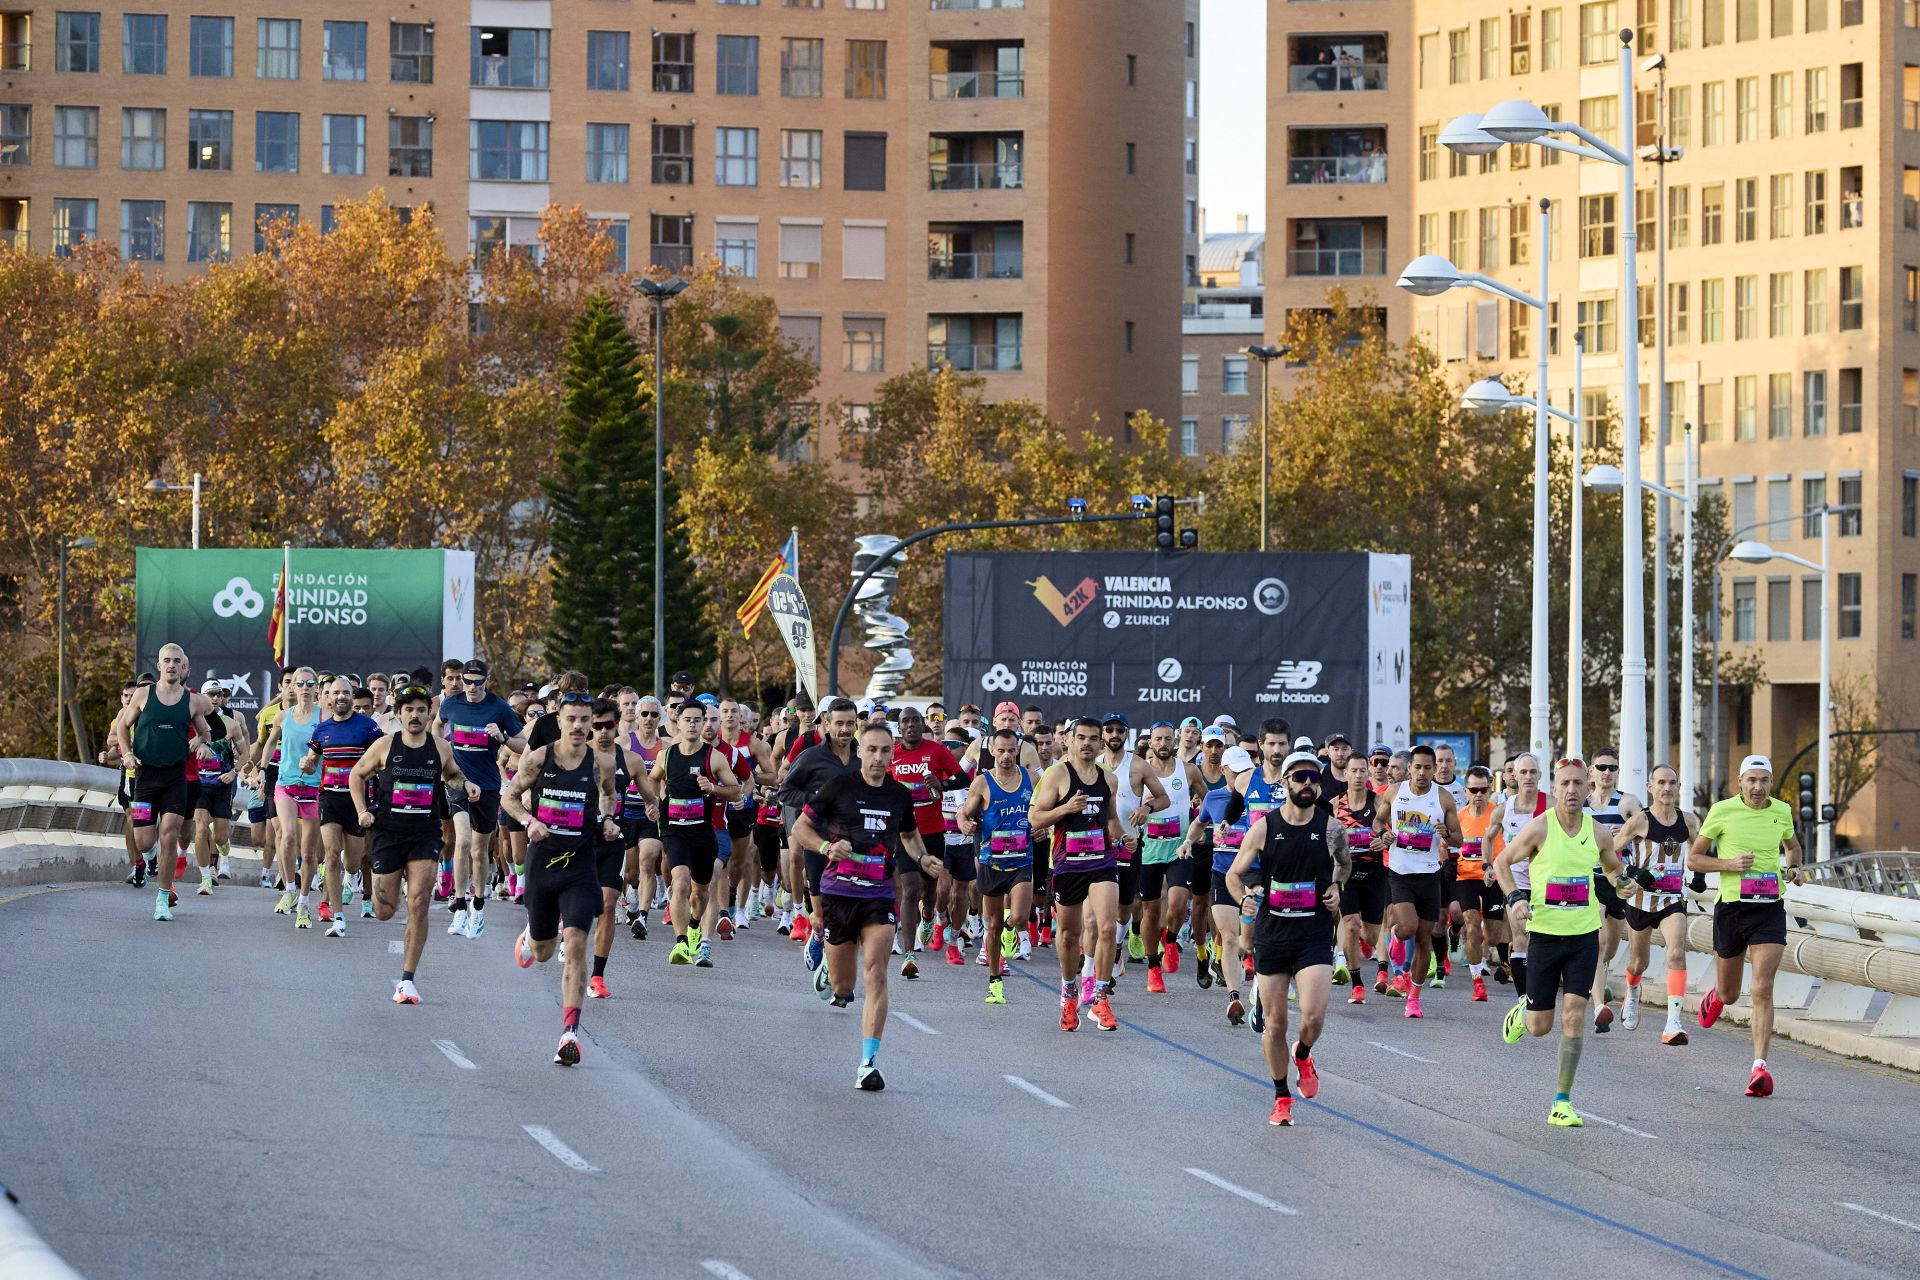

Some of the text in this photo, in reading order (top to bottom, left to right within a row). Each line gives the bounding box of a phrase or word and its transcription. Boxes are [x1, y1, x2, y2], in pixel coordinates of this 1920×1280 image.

[272, 572, 368, 585] FNDACIÓN
[1104, 576, 1171, 592] VALENCIA
[1063, 588, 1089, 616] 42K
[1104, 594, 1248, 611] TRINIDAD ALFONSO
[287, 607, 368, 626] LFONSO
[1124, 614, 1170, 626] ZURICH
[1022, 659, 1088, 670] FUNDACIÓN
[1021, 671, 1088, 684] TRINIDAD
[1021, 684, 1088, 697] ALFONSO
[1138, 689, 1201, 702] ZURICH
[1255, 691, 1330, 704] new balance
[895, 763, 929, 775] KENYA
[542, 787, 587, 799] HANDSHAKE
[1000, 804, 1028, 817] FIAAL
